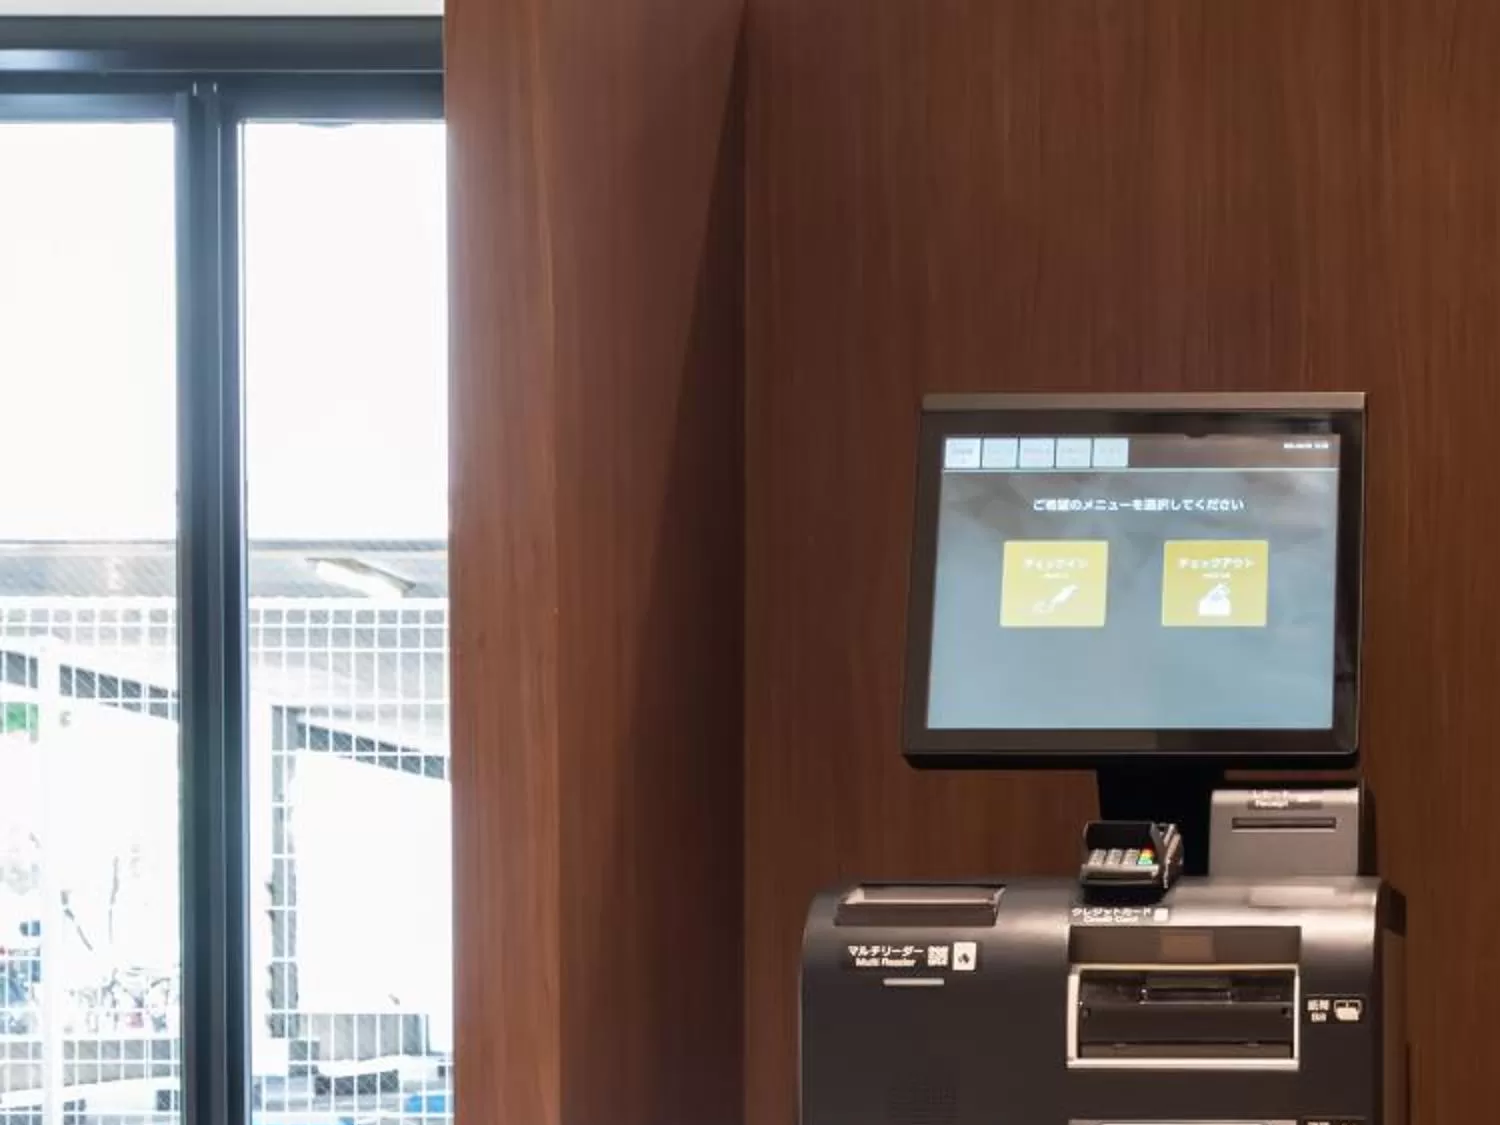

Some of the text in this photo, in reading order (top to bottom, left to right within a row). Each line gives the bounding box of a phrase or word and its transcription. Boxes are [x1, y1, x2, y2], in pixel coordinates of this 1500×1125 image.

[847, 945, 924, 957] マルチリーダー
